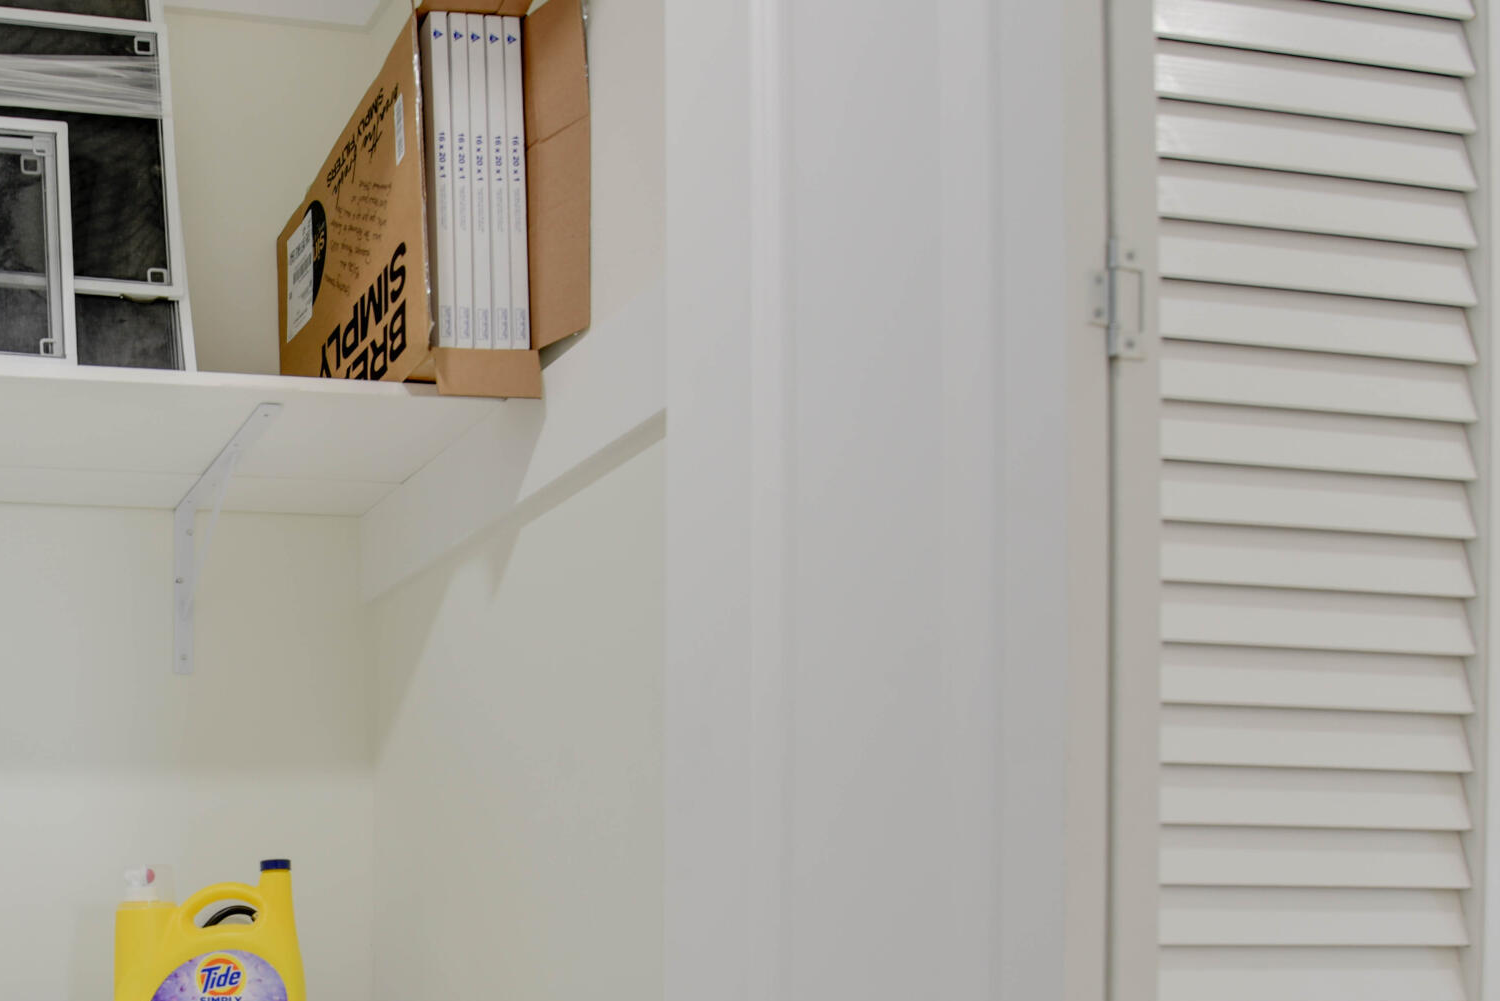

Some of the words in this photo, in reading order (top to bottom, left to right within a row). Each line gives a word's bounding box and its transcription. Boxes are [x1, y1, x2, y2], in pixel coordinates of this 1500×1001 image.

[356, 87, 384, 137] SIMPLY
[439, 152, 446, 163] 20
[459, 153, 466, 164] 20
[476, 155, 483, 166] 20
[495, 156, 502, 167] 20
[512, 156, 520, 167] 20
[319, 241, 407, 379] SIMPLY
[345, 298, 407, 381] BRE
[200, 965, 241, 994] Tide
